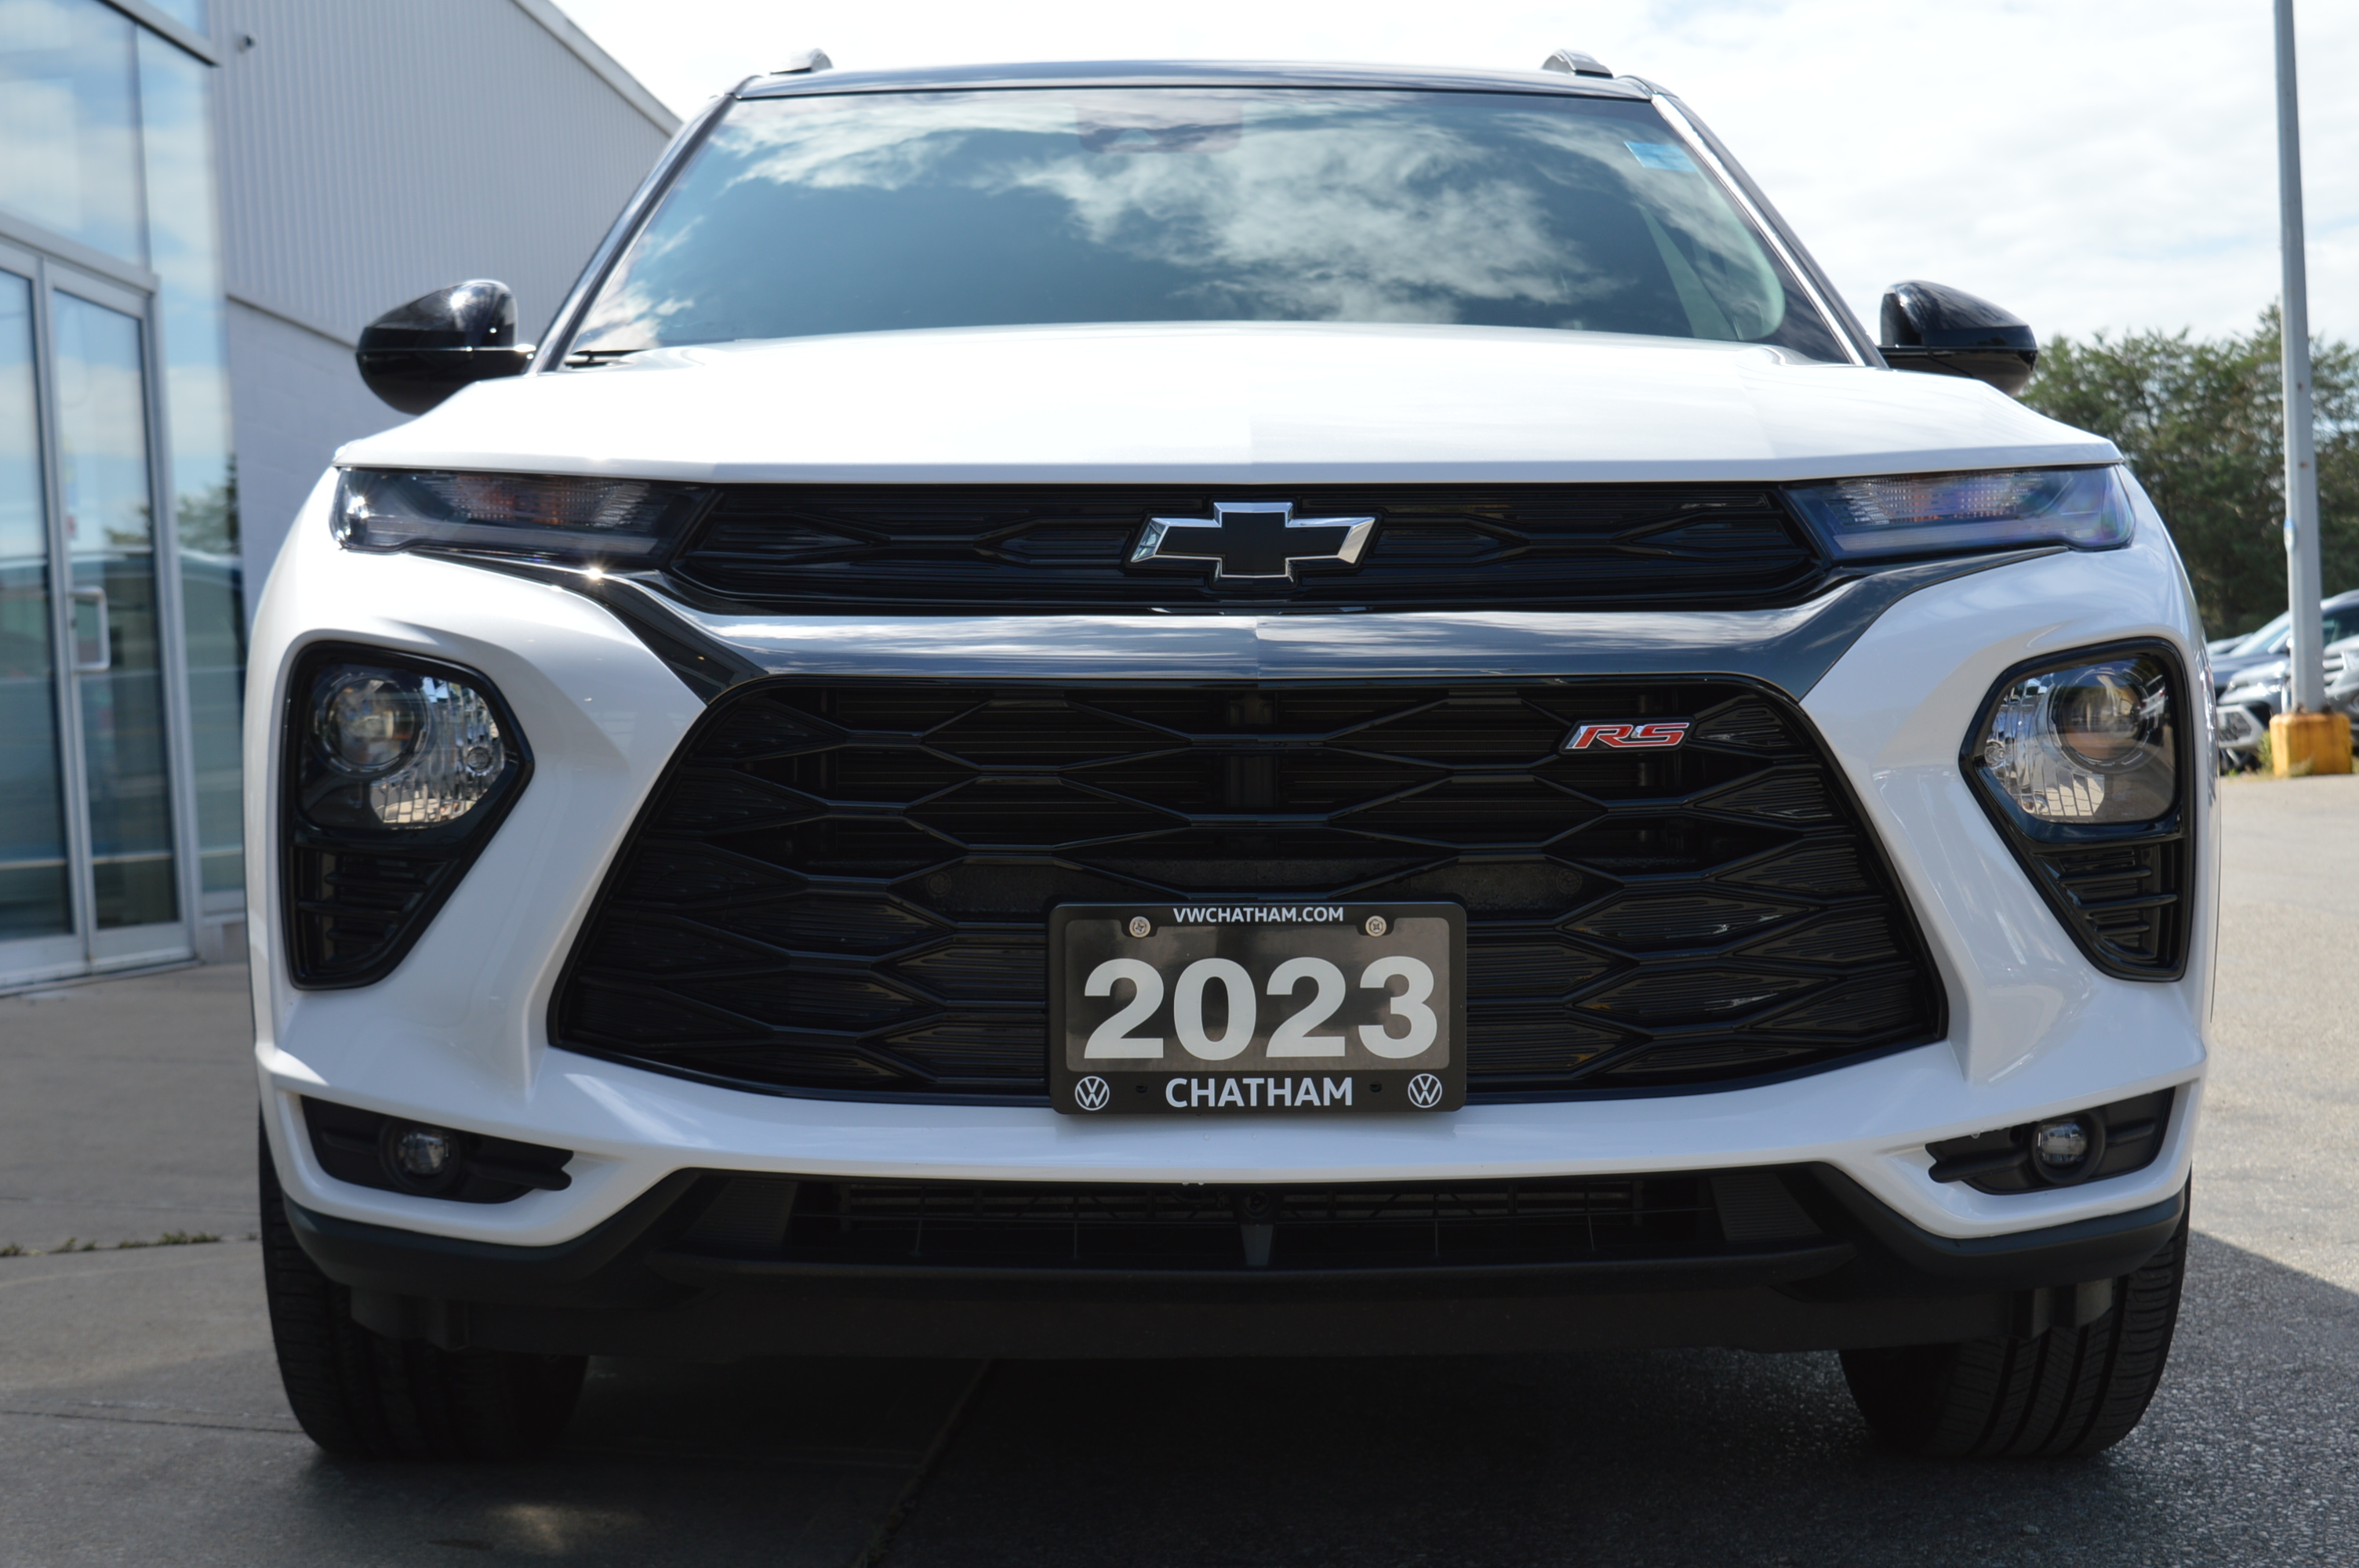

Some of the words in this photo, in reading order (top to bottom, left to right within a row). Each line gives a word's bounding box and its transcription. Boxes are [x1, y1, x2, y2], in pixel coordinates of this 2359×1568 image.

[1565, 722, 1690, 749] RS
[1173, 906, 1344, 923] VWCHATHAM.COM
[1084, 956, 1438, 1060] 2023
[1165, 1077, 1353, 1107] CHATHAM
